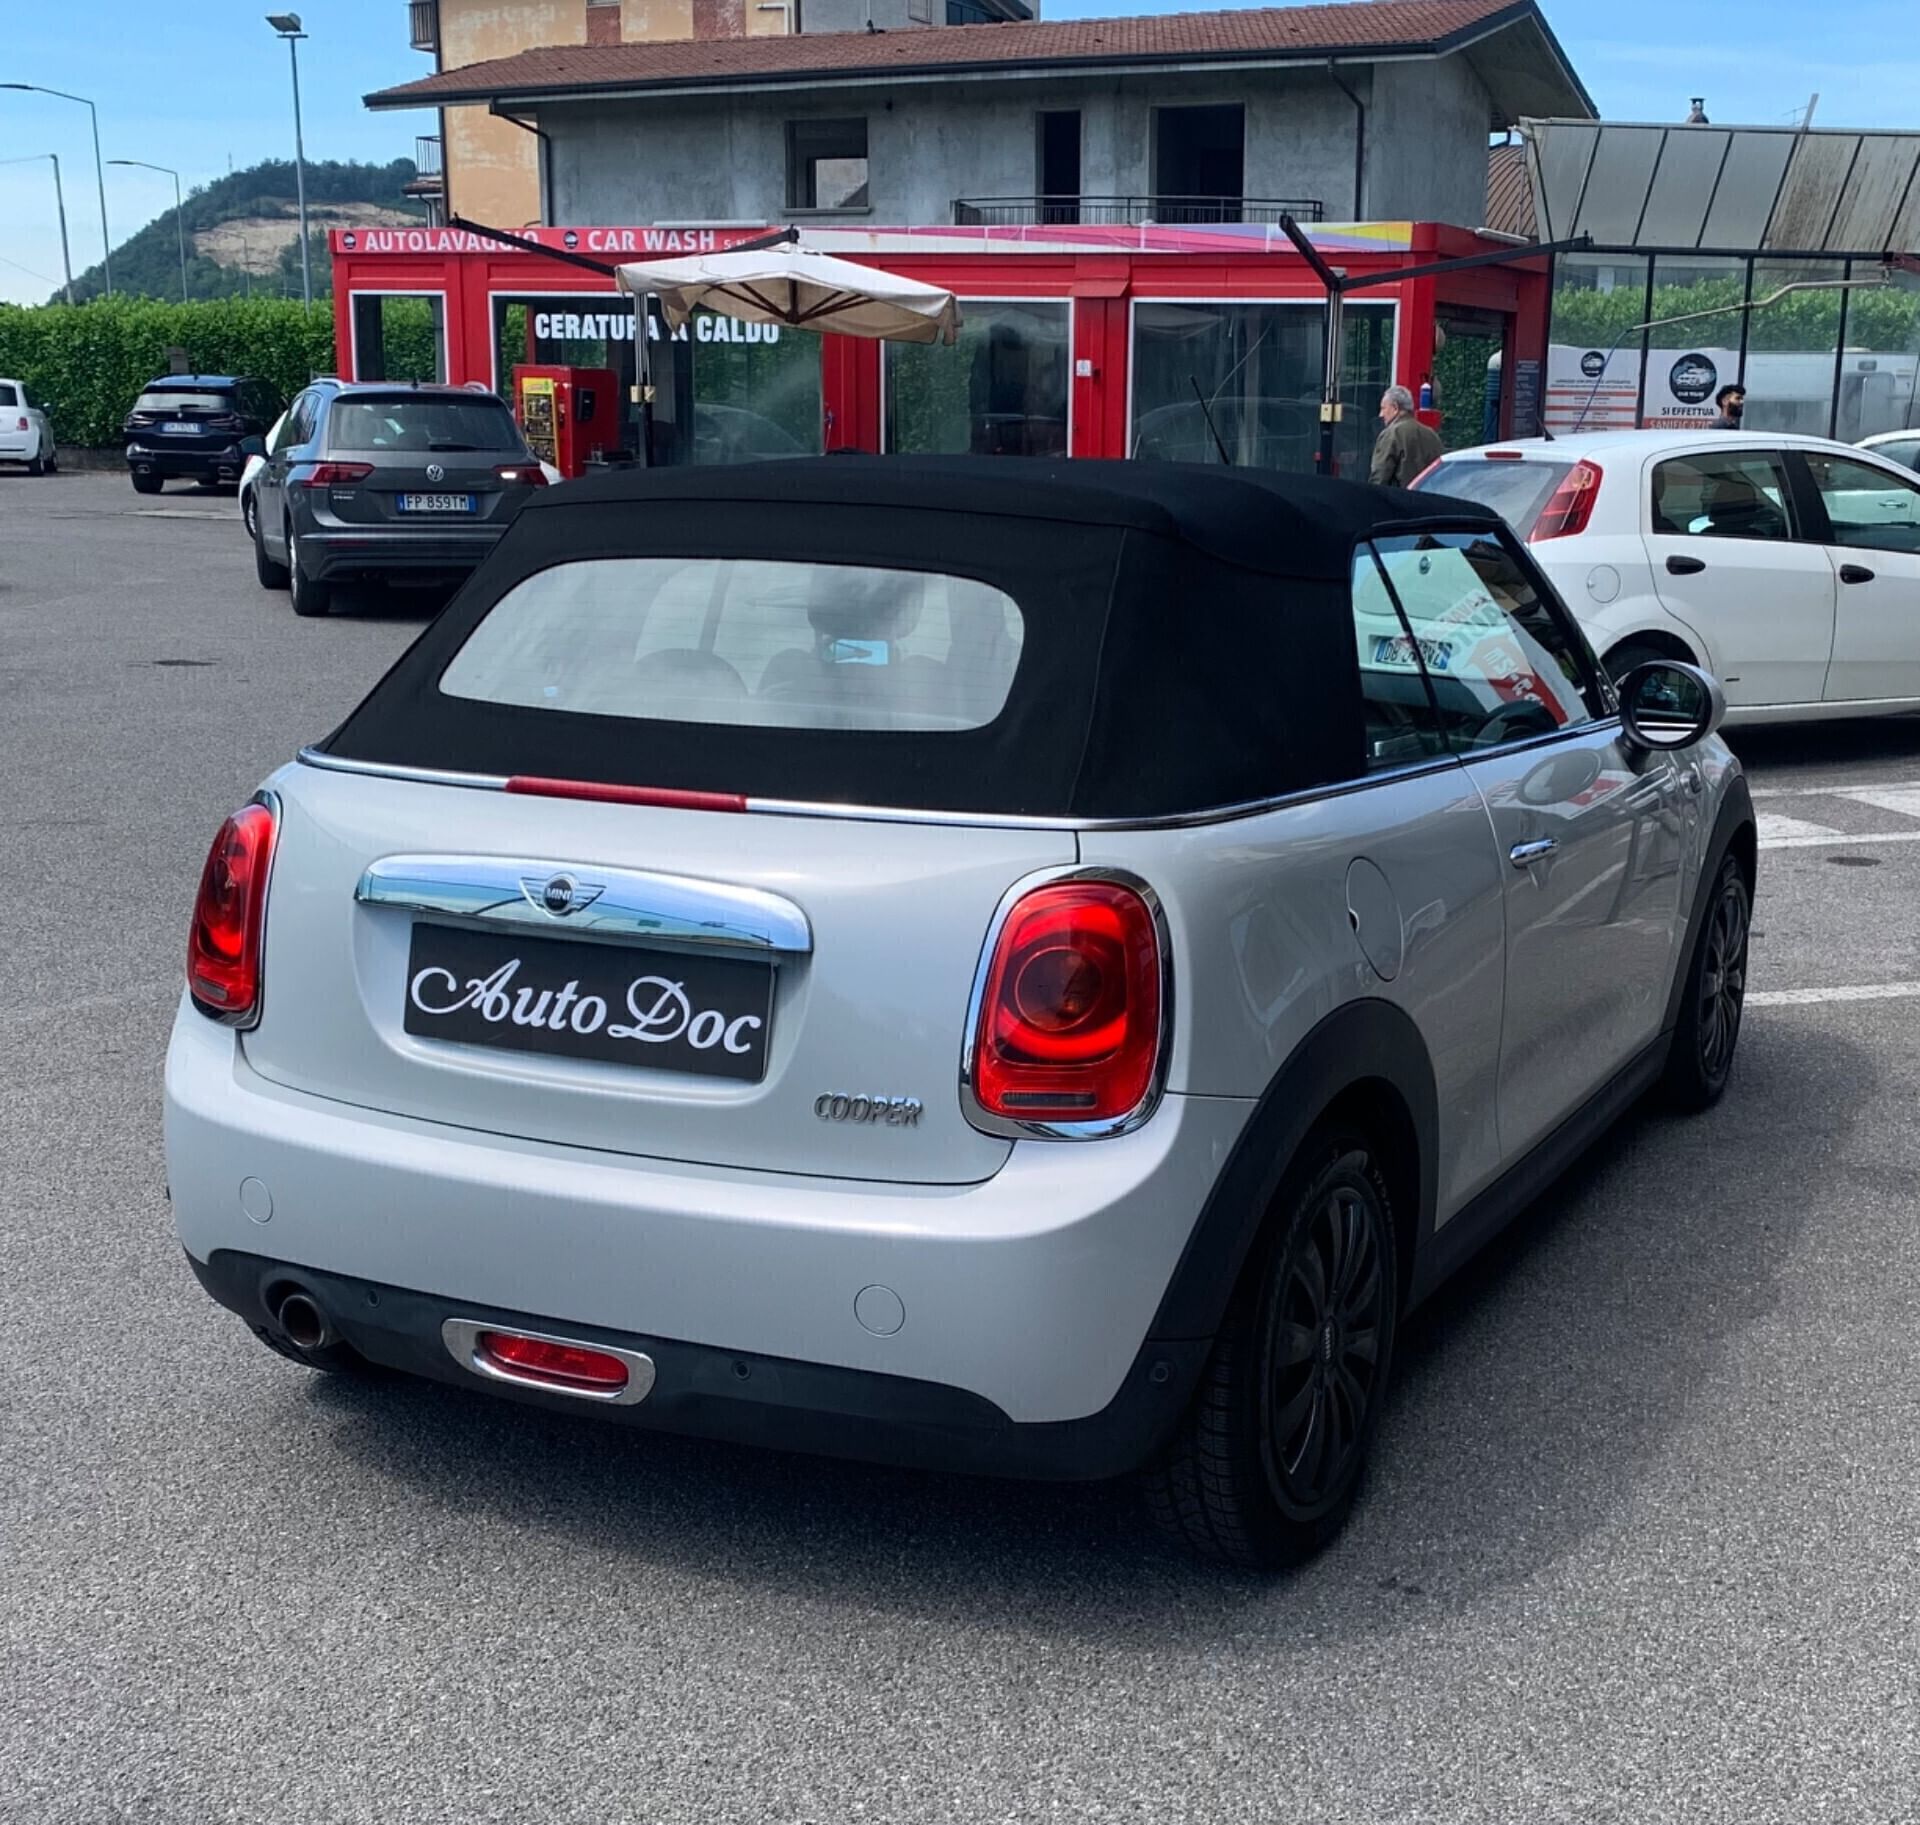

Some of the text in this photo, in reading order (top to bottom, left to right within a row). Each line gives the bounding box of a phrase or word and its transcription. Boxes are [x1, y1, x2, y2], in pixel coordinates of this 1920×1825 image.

[587, 230, 635, 251] CAR
[642, 230, 715, 251] WASH
[696, 316, 779, 343] CALDO
[546, 888, 572, 900] MINI
[411, 959, 761, 1054] Auto Doc
[814, 1091, 923, 1127] COOPER
